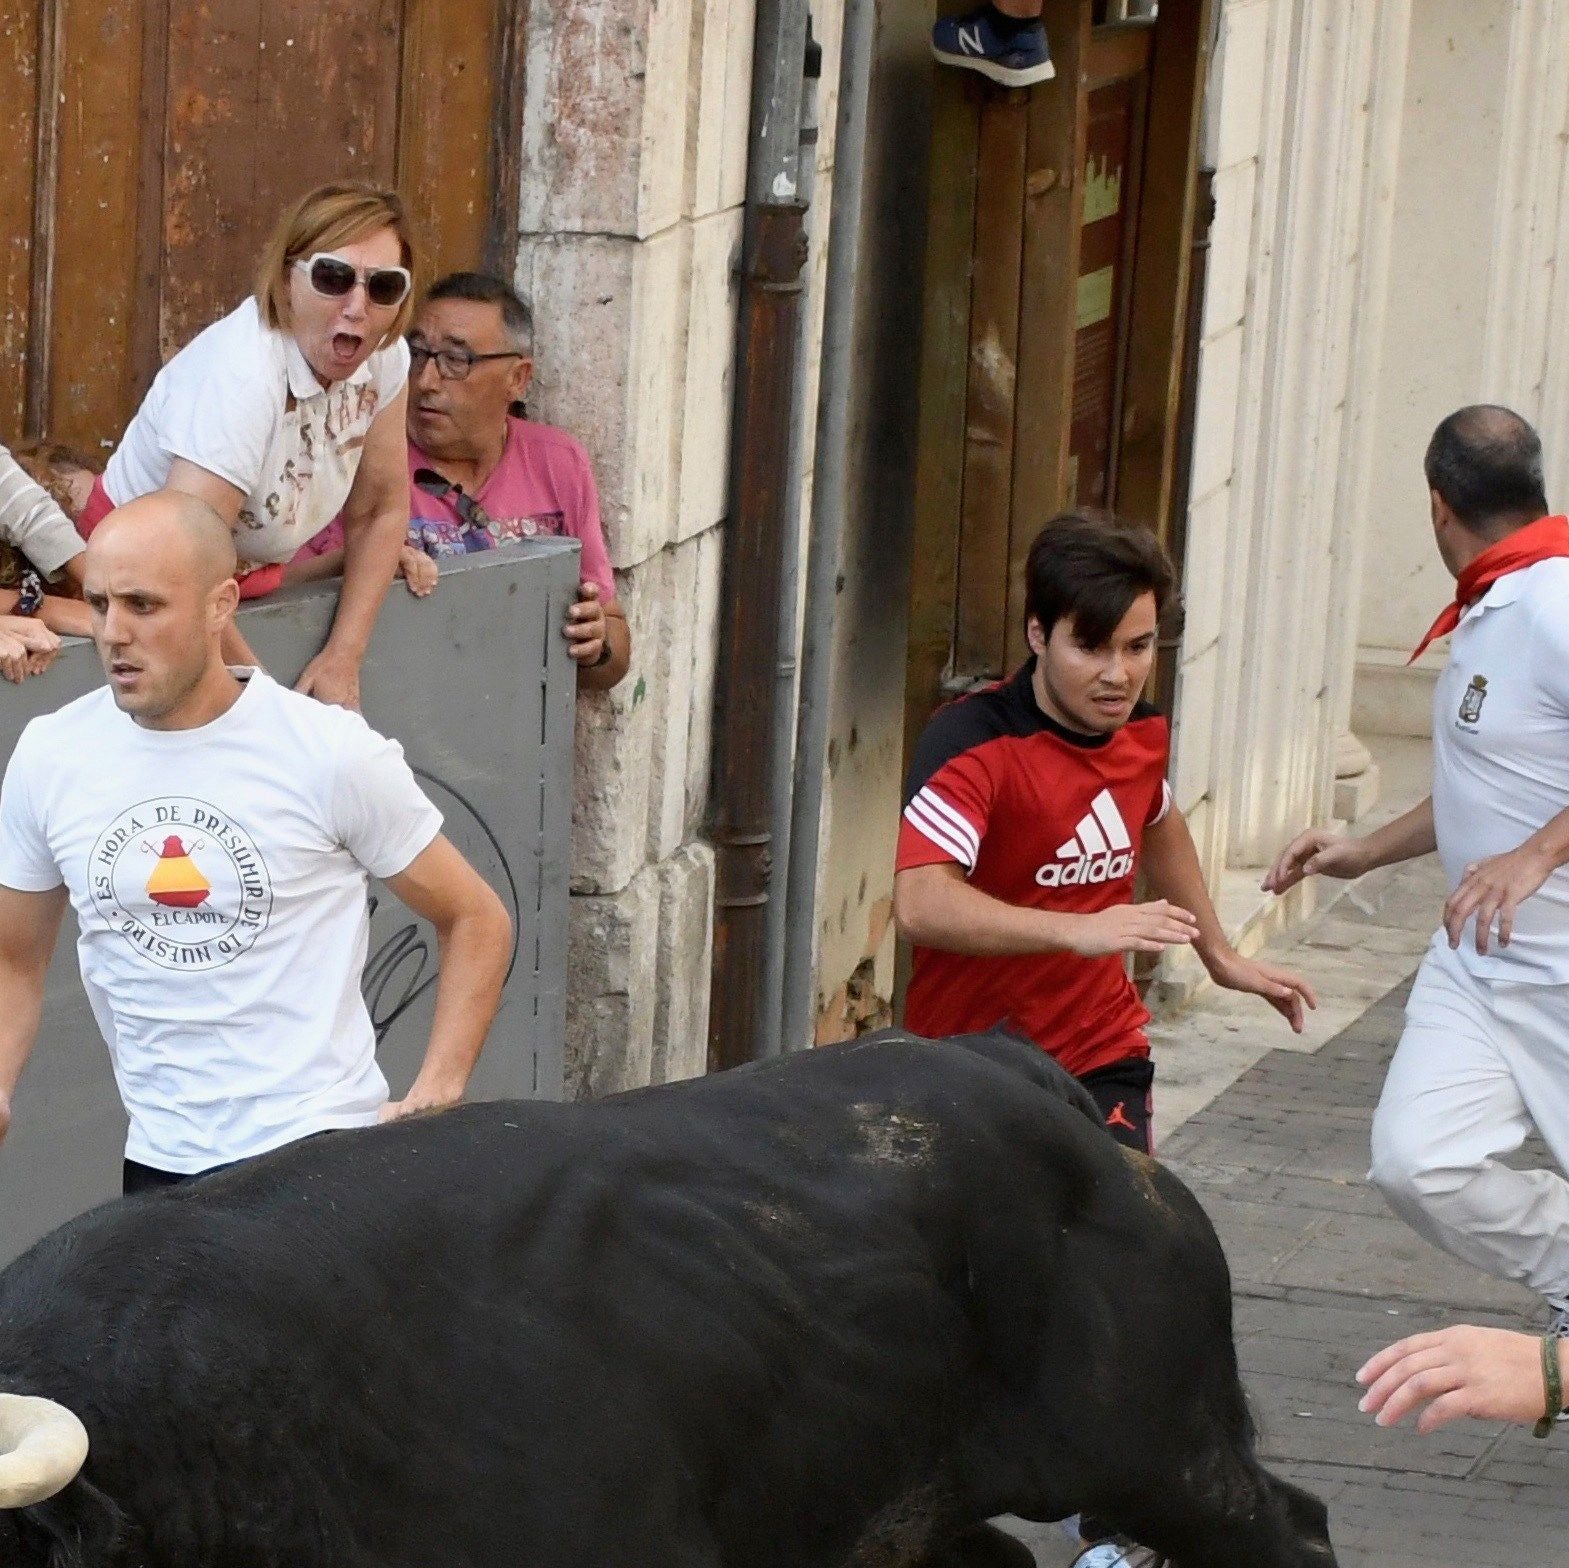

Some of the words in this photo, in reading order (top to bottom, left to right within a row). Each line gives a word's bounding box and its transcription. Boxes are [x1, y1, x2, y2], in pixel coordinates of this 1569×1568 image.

[154, 805, 181, 823] DE
[98, 816, 144, 866] HORA
[192, 808, 264, 899] PRESUMIR
[94, 874, 113, 902] ES
[240, 906, 263, 931] DE
[121, 920, 213, 964] NUESTRO
[217, 933, 243, 954] LO
